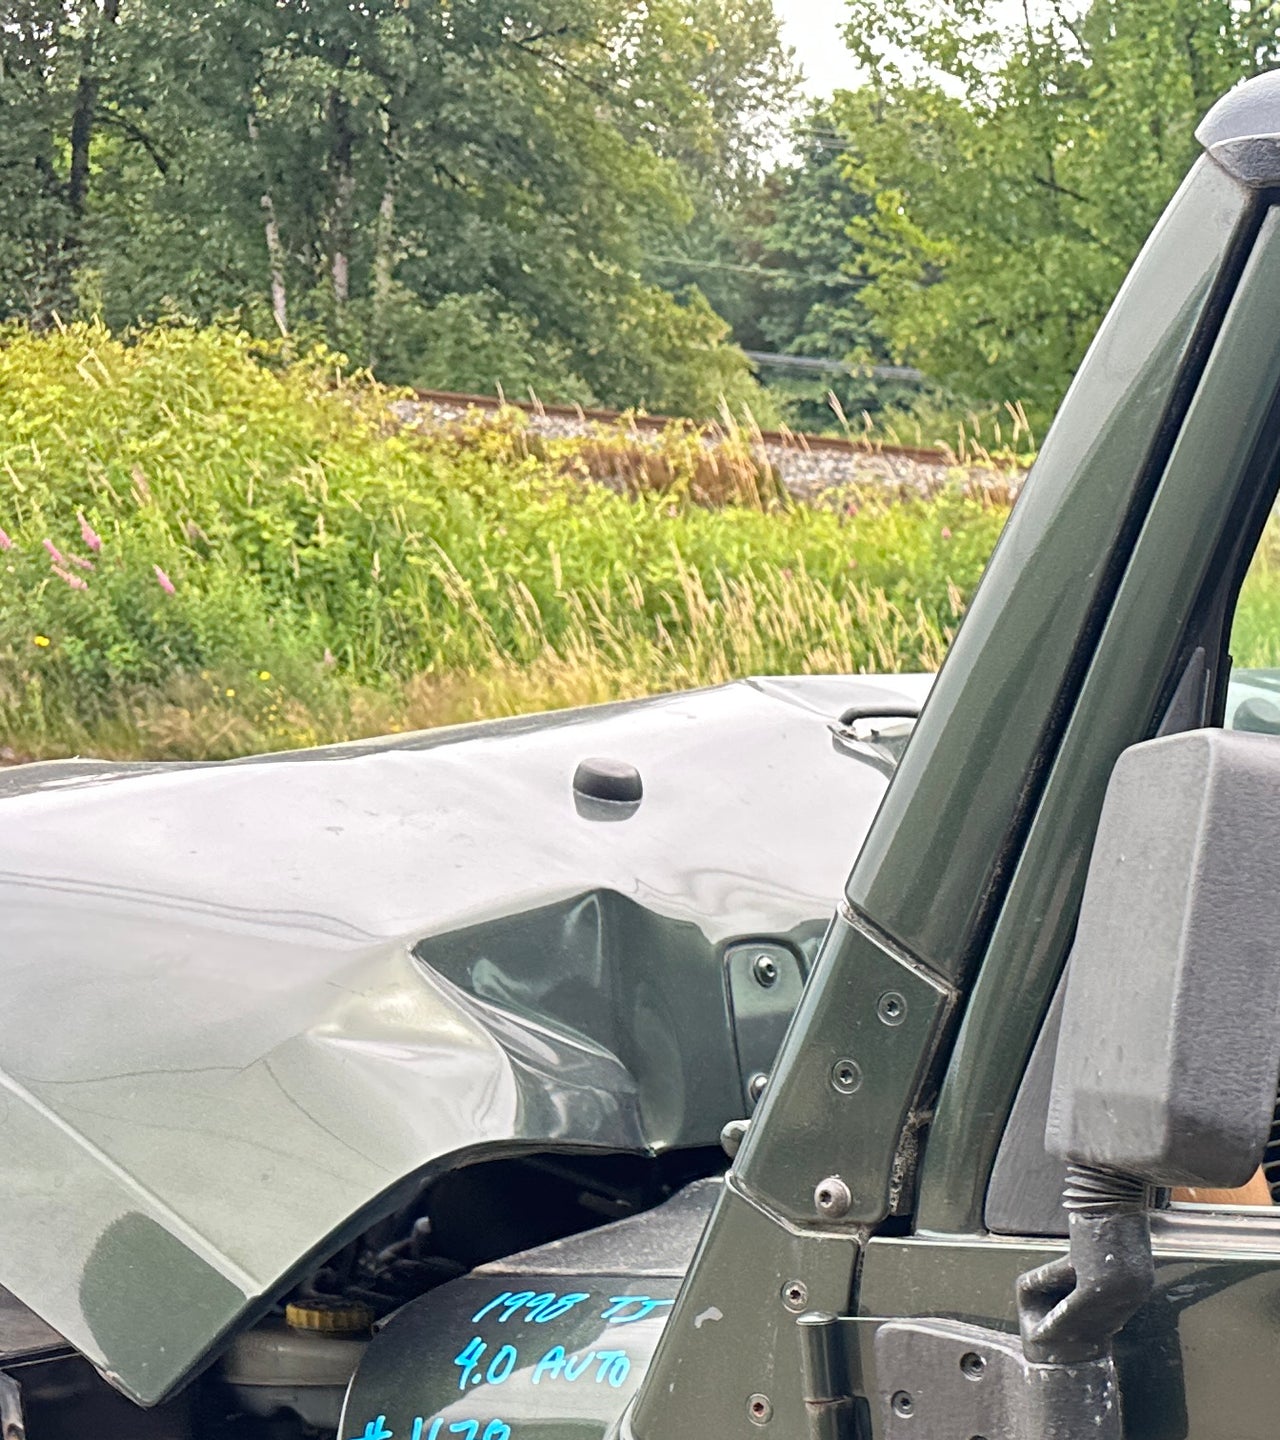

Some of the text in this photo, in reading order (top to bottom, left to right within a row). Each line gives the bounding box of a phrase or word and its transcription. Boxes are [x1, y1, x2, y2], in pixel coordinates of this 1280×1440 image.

[472, 1290, 676, 1324] 1998 TJ
[454, 1336, 632, 1390] 4.0 AUTO
